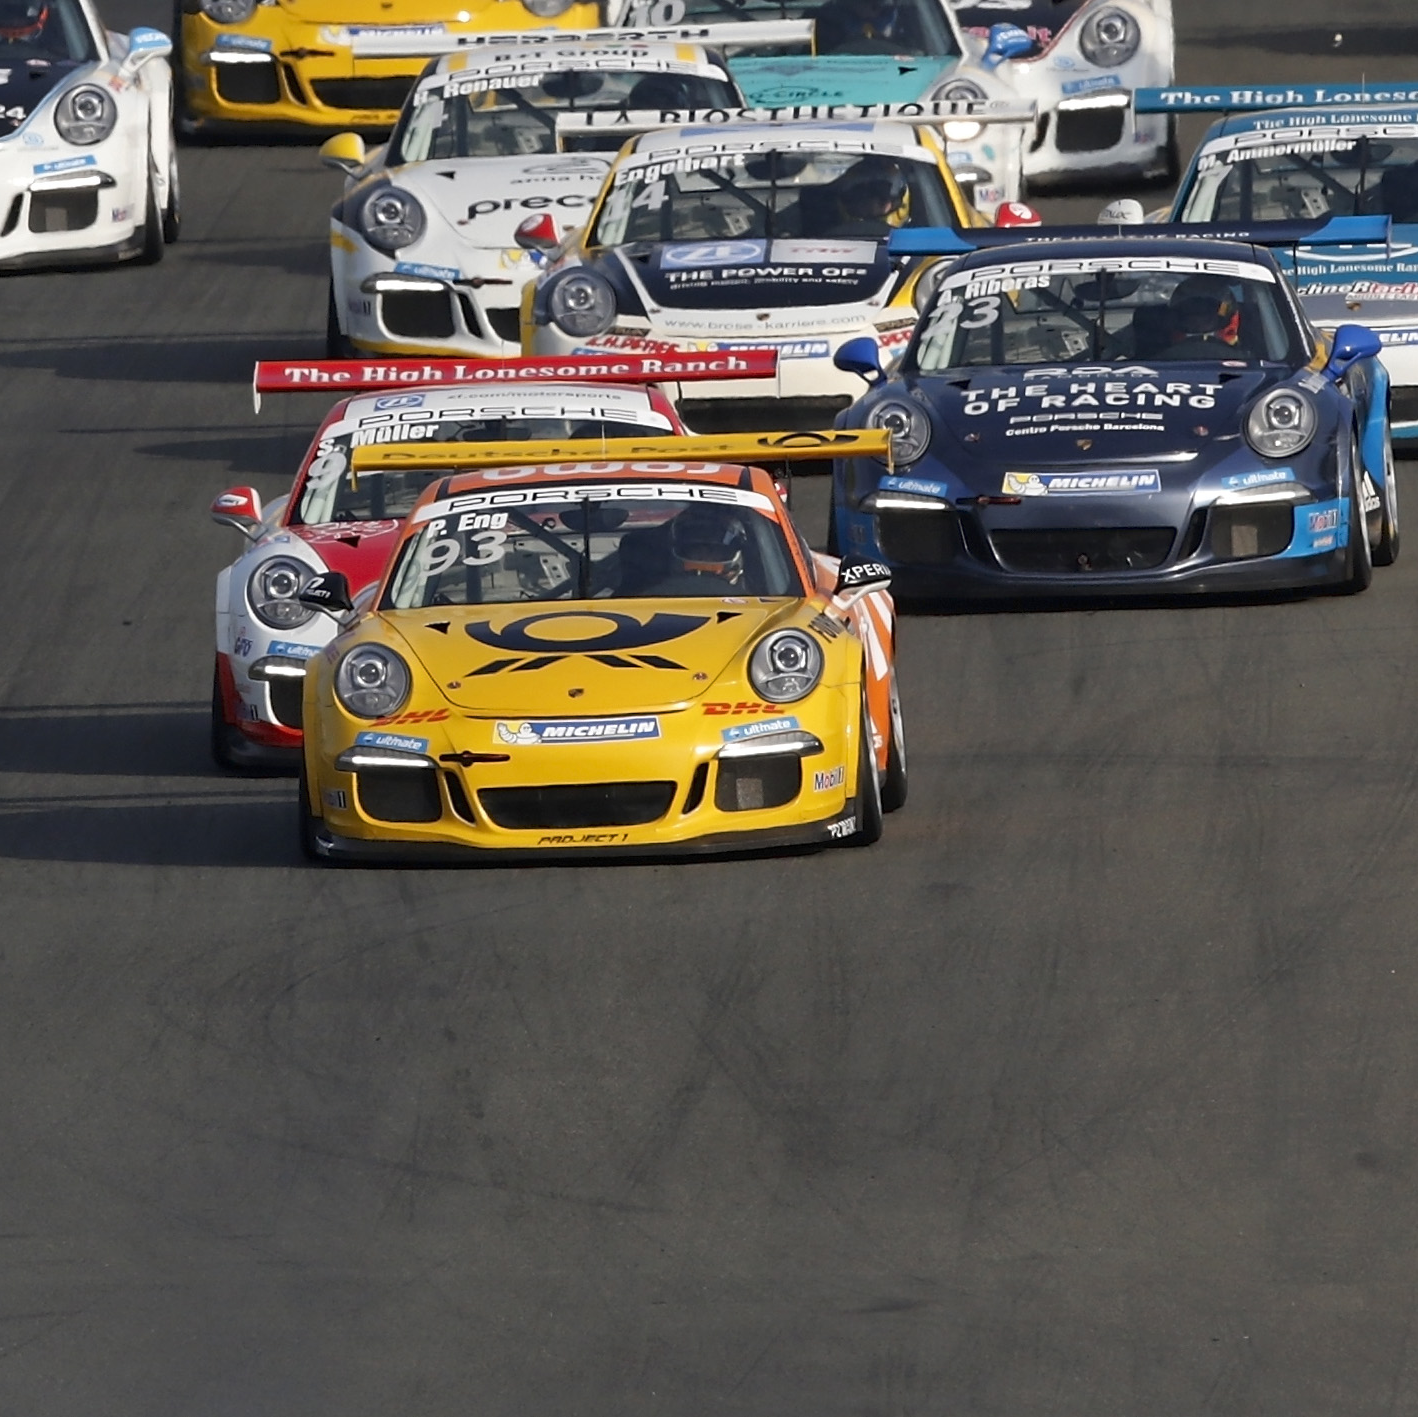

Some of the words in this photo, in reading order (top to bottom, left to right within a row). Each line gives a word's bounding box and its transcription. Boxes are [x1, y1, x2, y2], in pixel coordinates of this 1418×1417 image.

[442, 72, 545, 99] Renauer
[1160, 91, 1222, 106] The
[1230, 89, 1305, 106] High
[1253, 120, 1286, 130] The
[1288, 115, 1328, 127] High
[1330, 112, 1413, 125] Lonesome
[615, 154, 746, 186] Engelhart
[665, 269, 714, 283] THE
[722, 267, 814, 279] POWER
[971, 260, 1239, 281] PORSCHE
[1298, 263, 1328, 276] High
[1330, 261, 1394, 274] Lonesome
[966, 275, 1052, 300] Riberas
[284, 367, 351, 383] The
[361, 364, 442, 382] High
[453, 362, 630, 381] Lonesome
[641, 355, 749, 375] Ranch
[961, 384, 1050, 403] THE
[1070, 382, 1223, 396] HEART
[963, 397, 1022, 417] OF
[1041, 393, 1217, 410] RACING
[359, 405, 638, 429] PORSCHE
[1009, 411, 1164, 425] PORSCHE
[349, 422, 440, 449] Müller
[1005, 426, 1047, 437] Centro
[1049, 423, 1101, 433] Porsche
[1103, 422, 1165, 433] Barcelona
[631, 443, 735, 455] Post
[1048, 473, 1156, 490] MICHELIN
[1243, 470, 1287, 486] ultimate
[897, 480, 942, 495] ultimate
[448, 487, 738, 512] PORSCHE
[426, 518, 450, 537] P.
[457, 511, 509, 532] Eng
[420, 531, 508, 578] 93
[368, 707, 451, 728] DHL
[701, 701, 785, 716] DHL
[541, 721, 656, 739] MICHELIN
[743, 718, 792, 736] ultimate
[375, 734, 423, 751] ultimate
[536, 834, 615, 846] PROJECT
